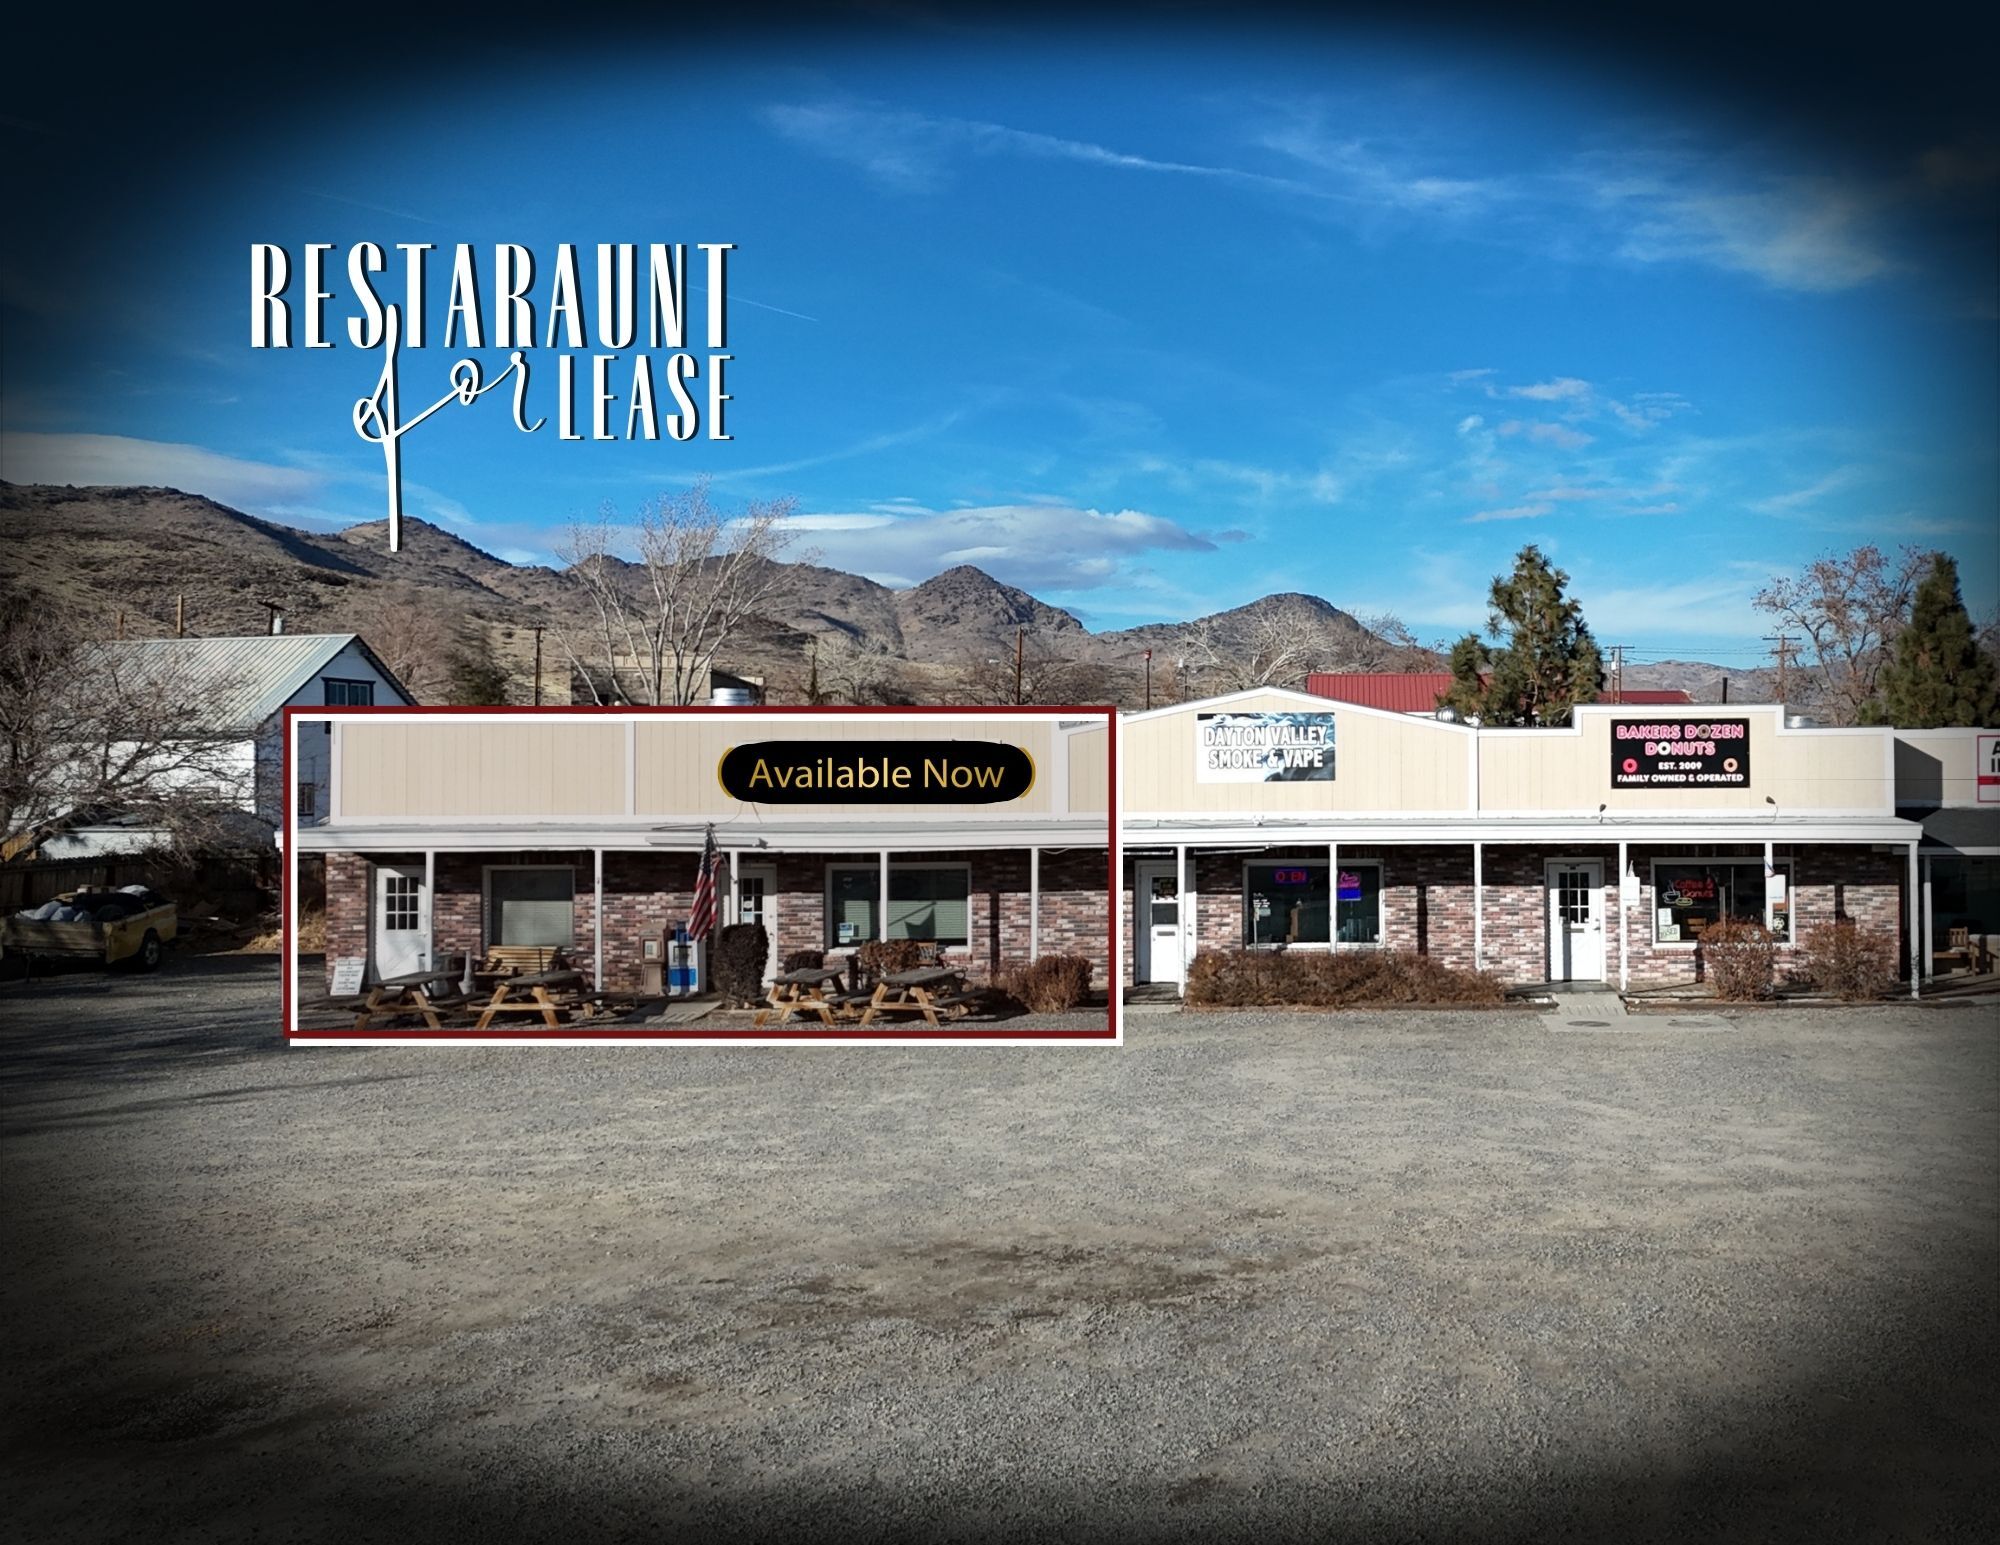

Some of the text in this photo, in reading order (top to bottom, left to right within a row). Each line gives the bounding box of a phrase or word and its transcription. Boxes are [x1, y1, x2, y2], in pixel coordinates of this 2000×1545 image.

[1204, 725, 1328, 746] DAYTON VALLEY
[1616, 724, 1744, 739] BAKERS DOZEN
[1645, 741, 1716, 755] DONUTS
[1208, 748, 1324, 769] SMOKE & VAPE
[1658, 761, 1702, 770] EST. 2009
[1617, 774, 1650, 783] FAMILY
[1651, 774, 1687, 782] OWNED
[1696, 773, 1744, 782] OPERATED
